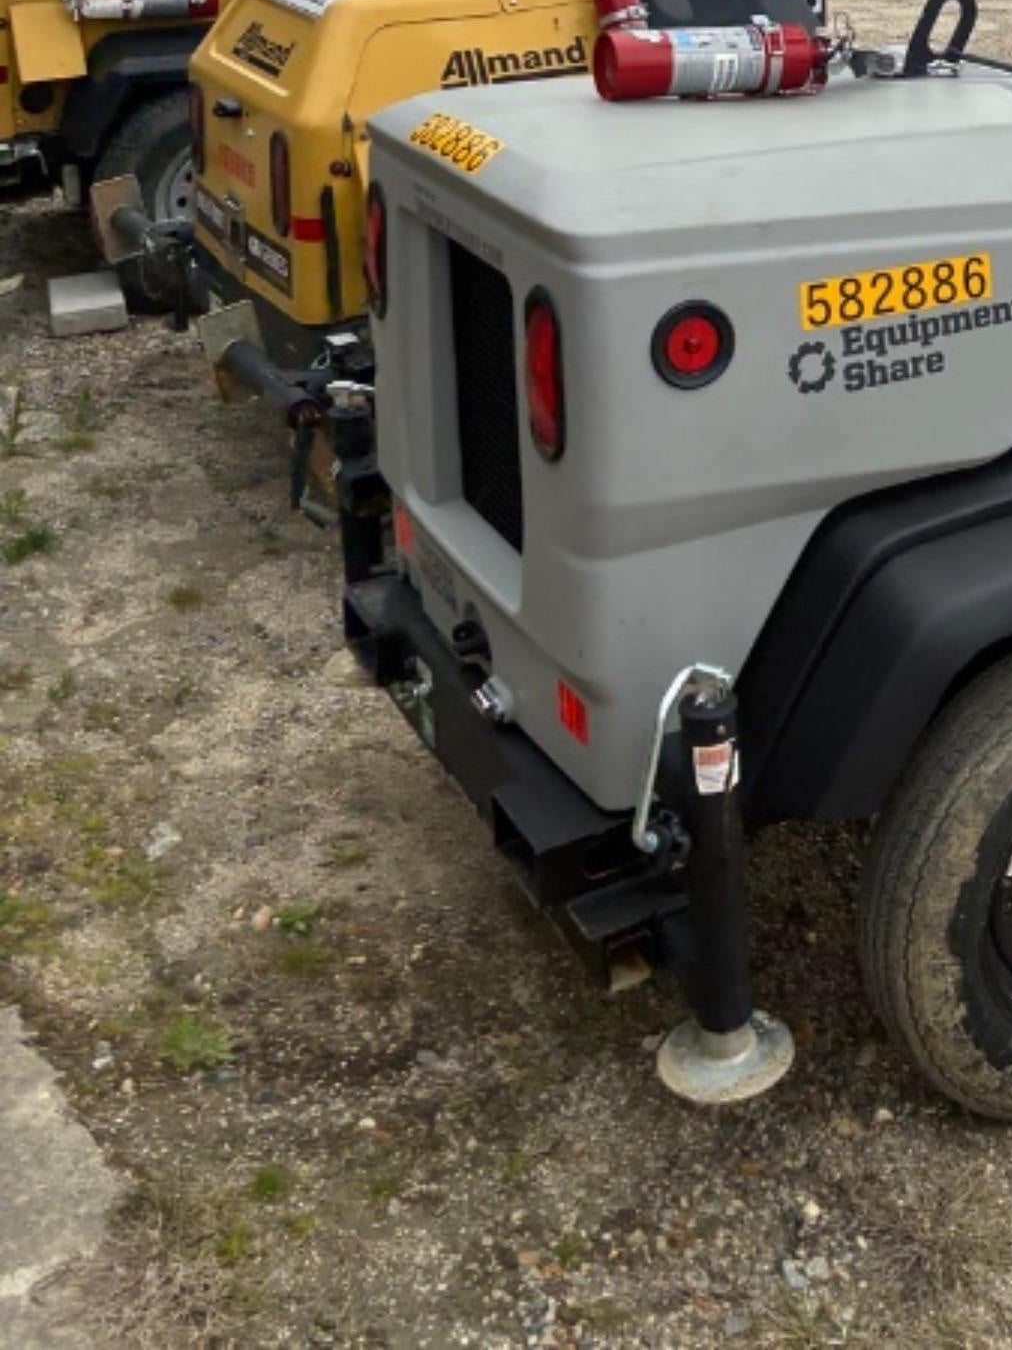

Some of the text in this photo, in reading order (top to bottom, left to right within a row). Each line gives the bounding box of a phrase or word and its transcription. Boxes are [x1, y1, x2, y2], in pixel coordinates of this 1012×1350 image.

[440, 35, 586, 88] Allmand
[806, 256, 987, 326] 582886
[842, 351, 945, 392] Share
